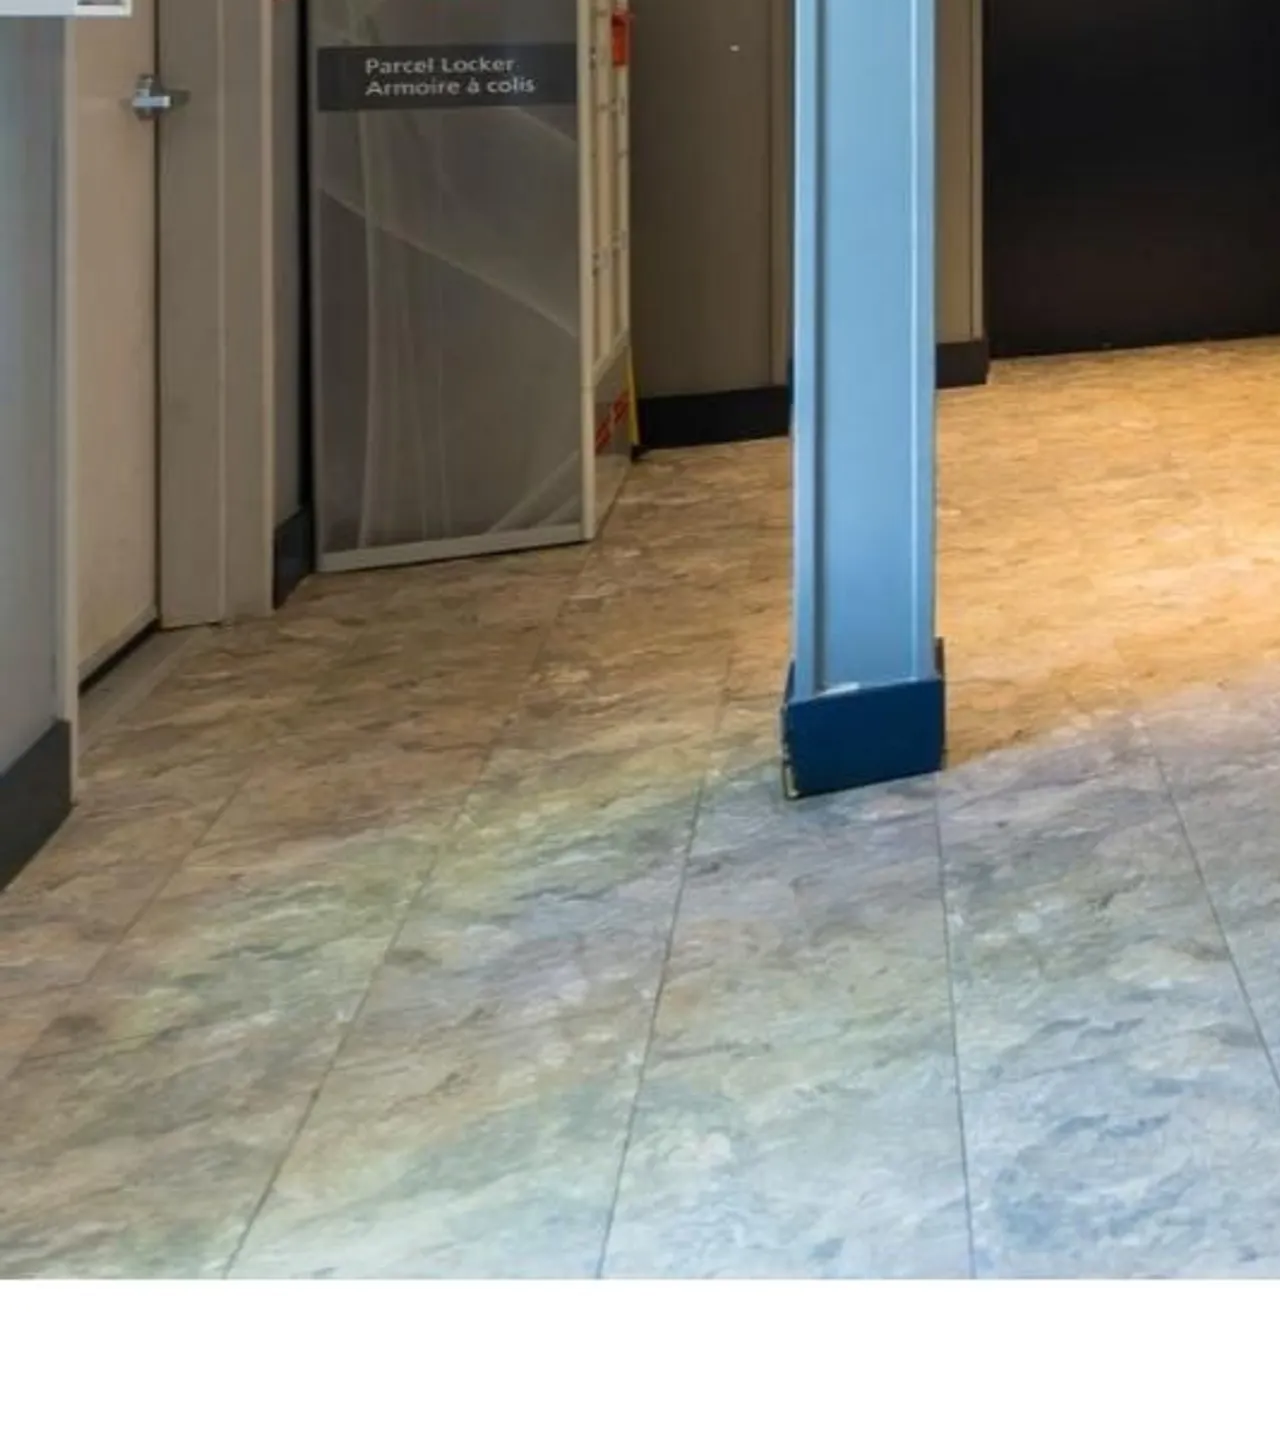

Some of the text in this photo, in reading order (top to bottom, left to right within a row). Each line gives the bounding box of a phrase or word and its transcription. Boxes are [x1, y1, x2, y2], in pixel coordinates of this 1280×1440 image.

[364, 56, 515, 74] Parcel Locker
[364, 78, 461, 96] Armoire
[486, 76, 536, 94] colis
